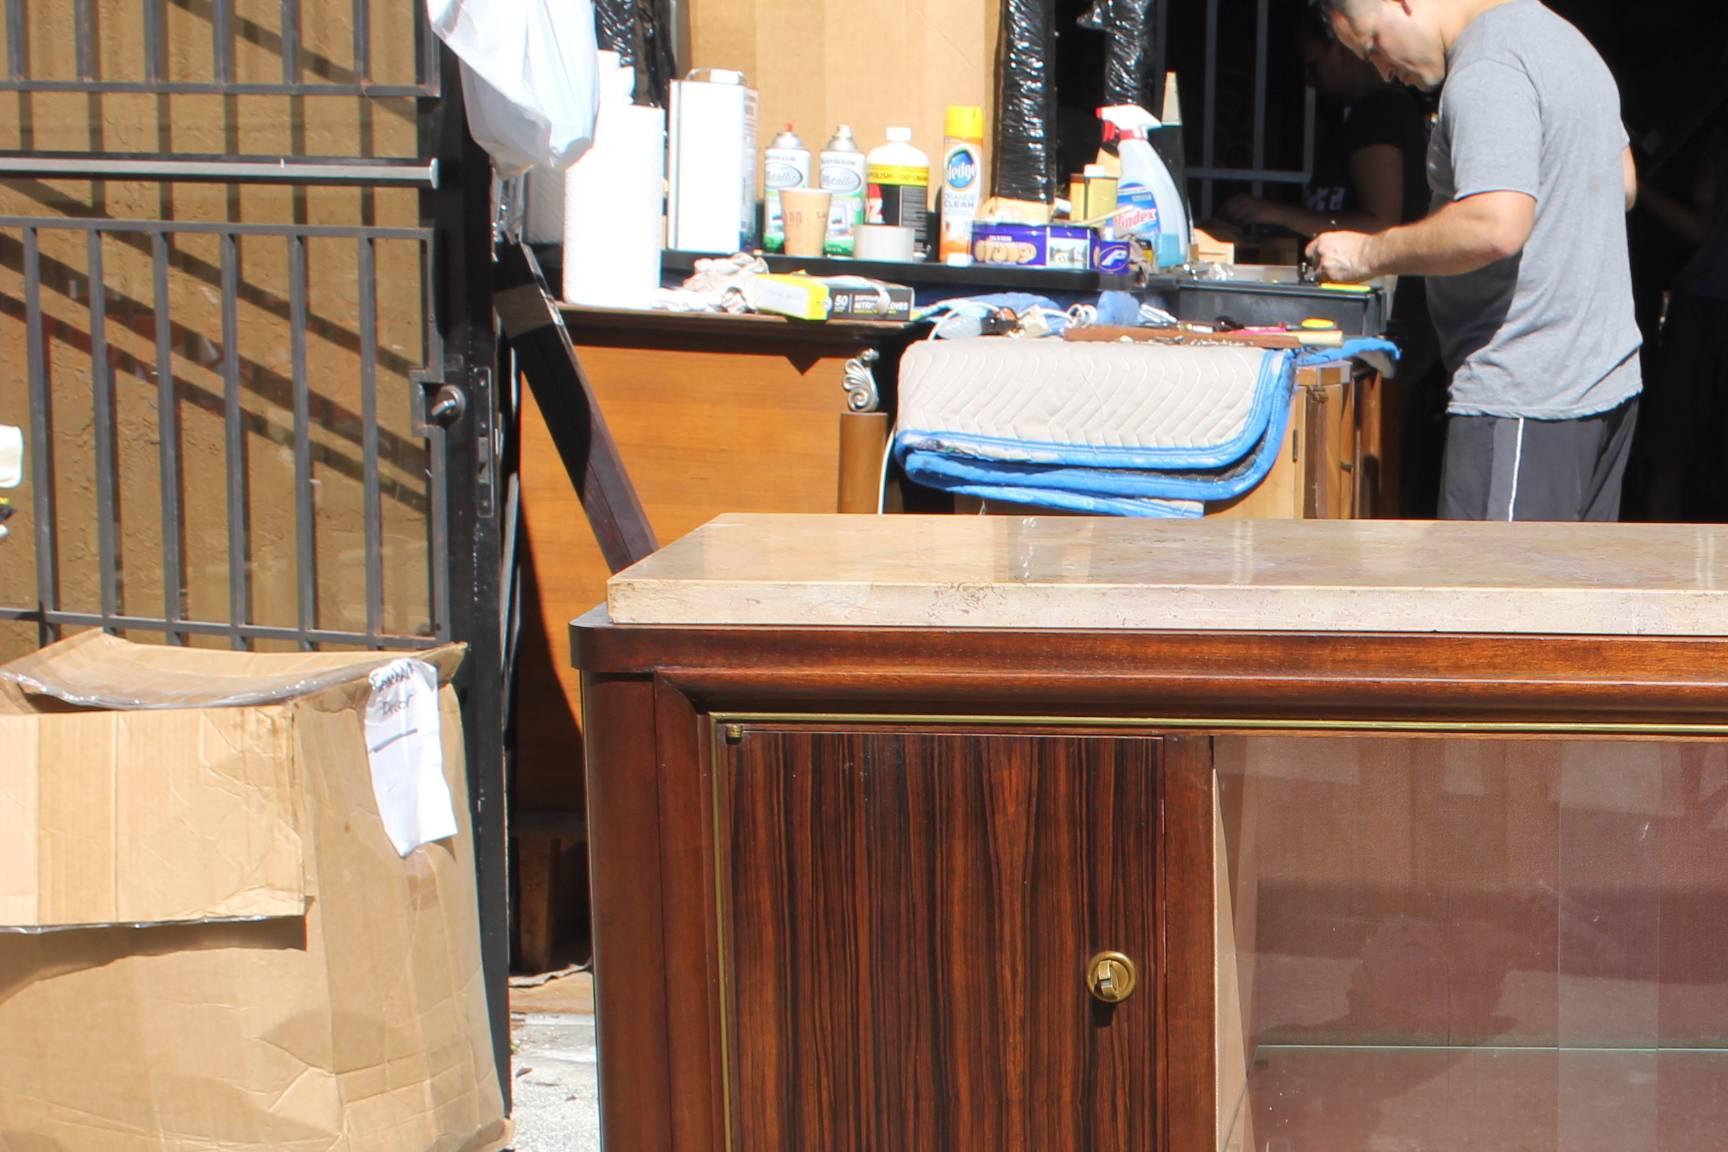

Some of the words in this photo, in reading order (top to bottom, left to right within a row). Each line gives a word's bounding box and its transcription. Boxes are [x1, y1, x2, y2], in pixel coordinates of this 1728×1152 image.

[944, 162, 977, 181] ledge
[943, 200, 975, 208] CLEAN
[834, 294, 849, 306] 50
